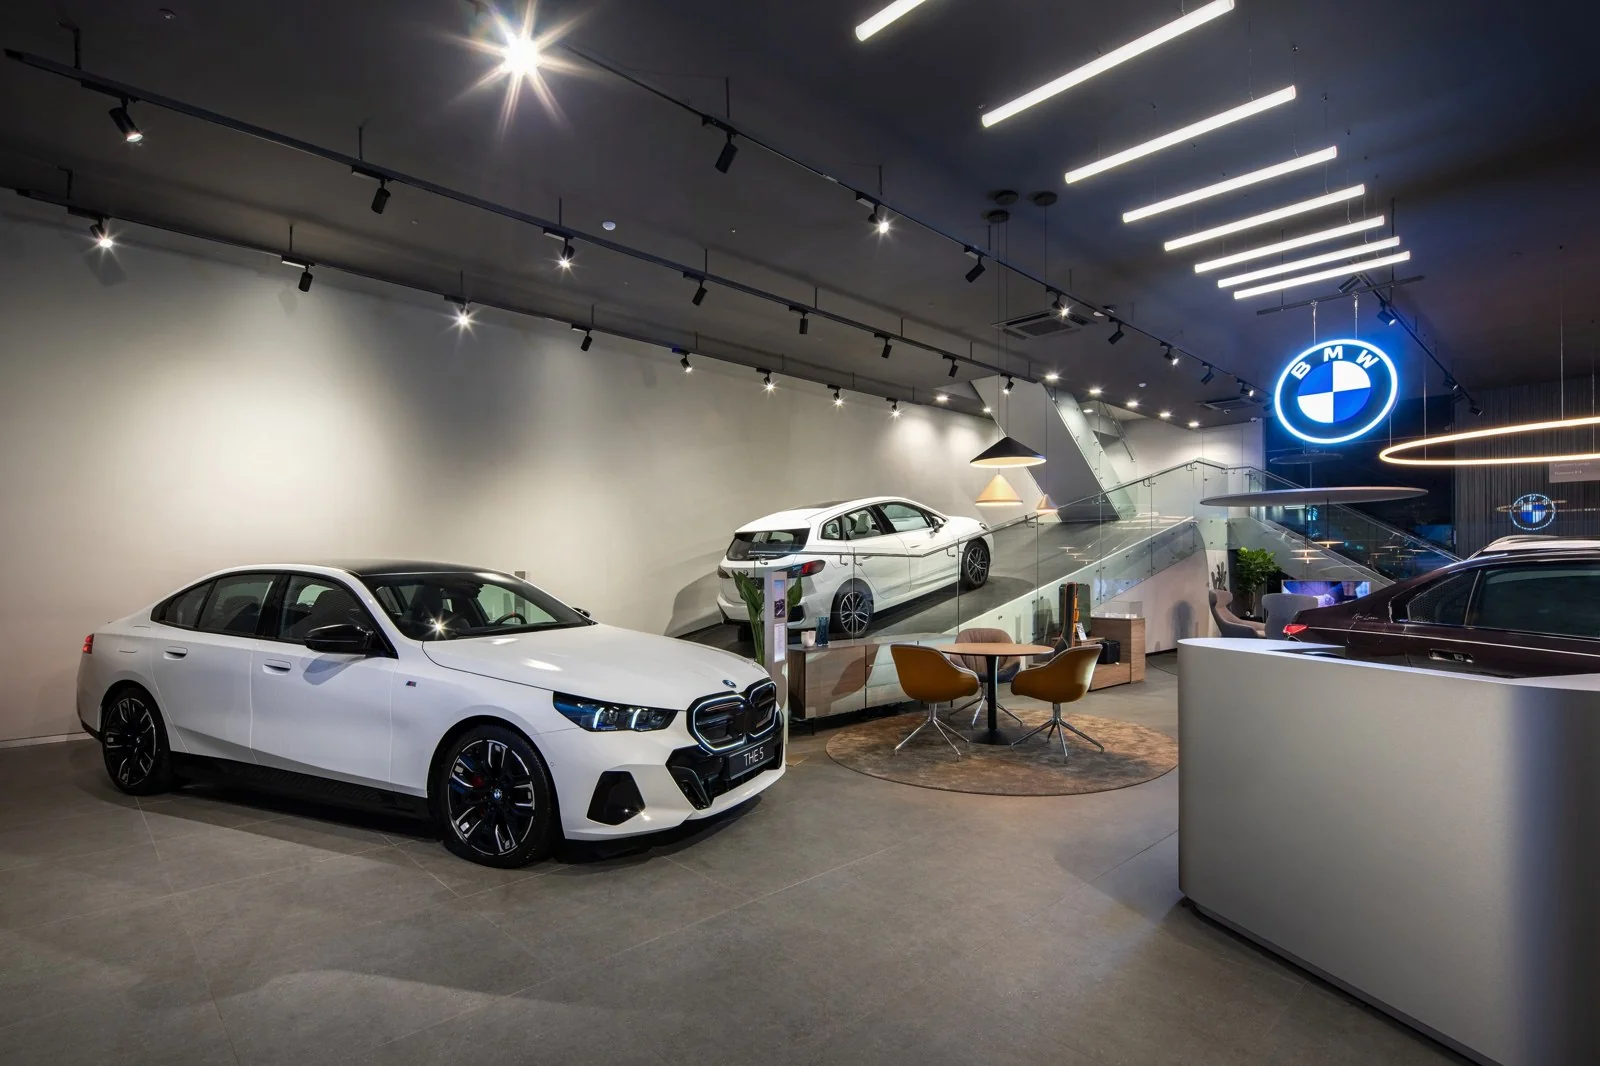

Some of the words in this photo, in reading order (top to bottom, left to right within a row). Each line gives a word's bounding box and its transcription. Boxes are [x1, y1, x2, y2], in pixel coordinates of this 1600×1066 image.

[1290, 345, 1380, 380] BMW
[743, 748, 759, 767] THE
[759, 746, 764, 760] 5
